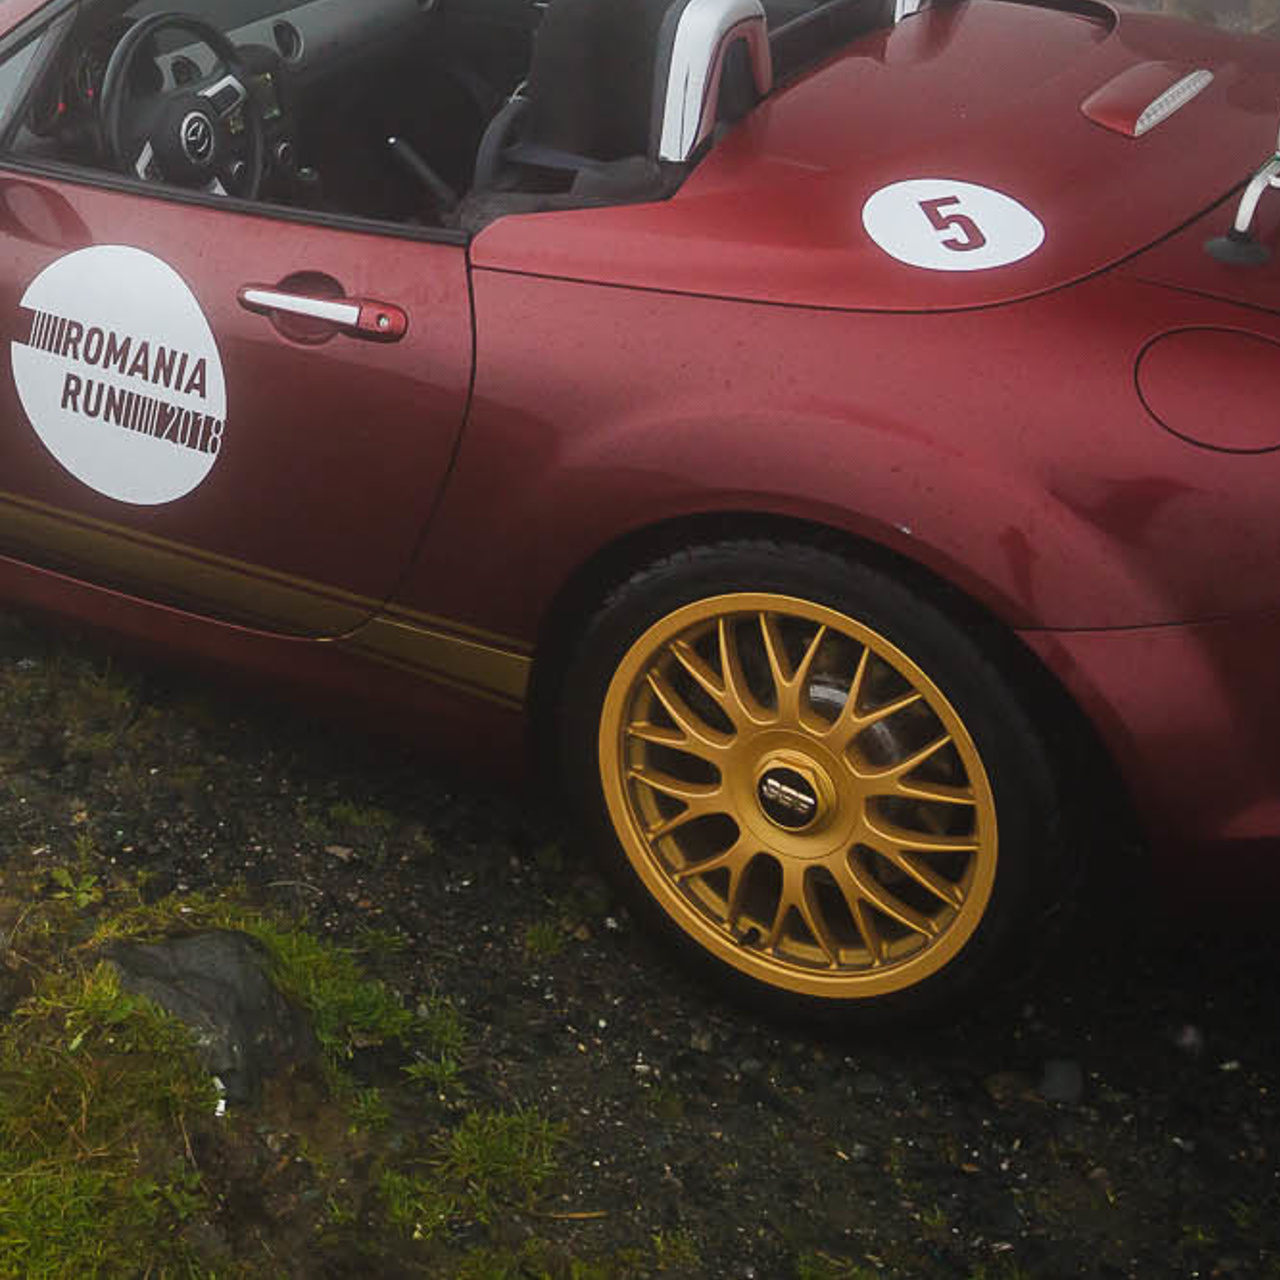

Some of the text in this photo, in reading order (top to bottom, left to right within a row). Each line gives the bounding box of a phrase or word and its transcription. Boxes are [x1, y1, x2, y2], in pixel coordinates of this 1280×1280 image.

[917, 195, 987, 252] 5
[60, 319, 208, 399] ROMANIA
[60, 372, 226, 457] RUN 2018
